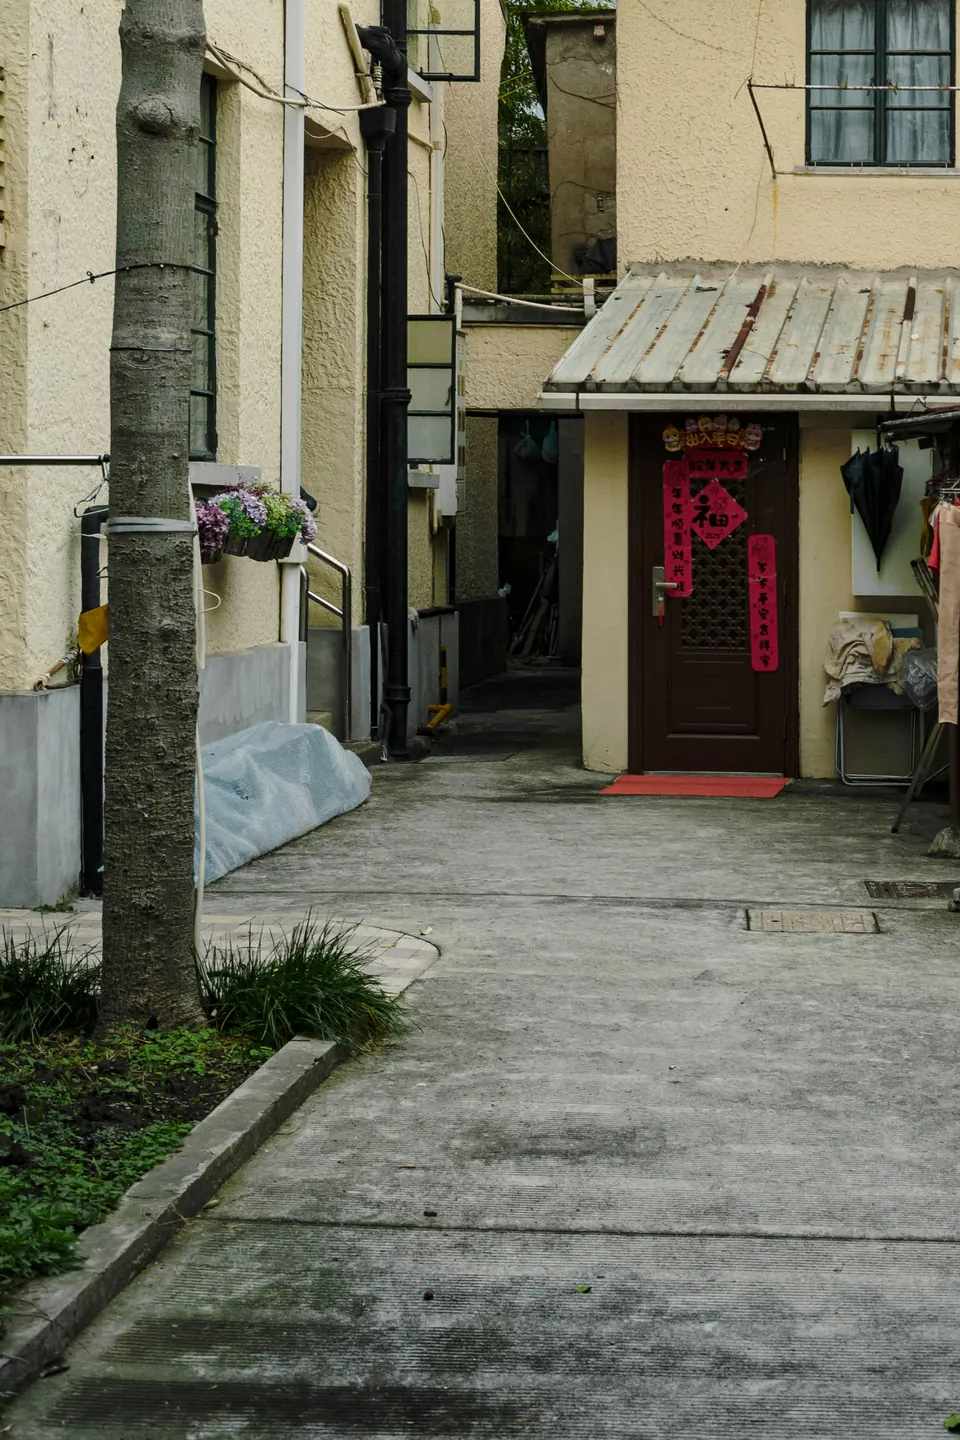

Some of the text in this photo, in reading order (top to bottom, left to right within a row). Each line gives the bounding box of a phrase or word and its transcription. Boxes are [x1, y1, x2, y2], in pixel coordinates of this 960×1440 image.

[686, 431, 740, 447] 出入平安
[692, 495, 728, 528] 福
